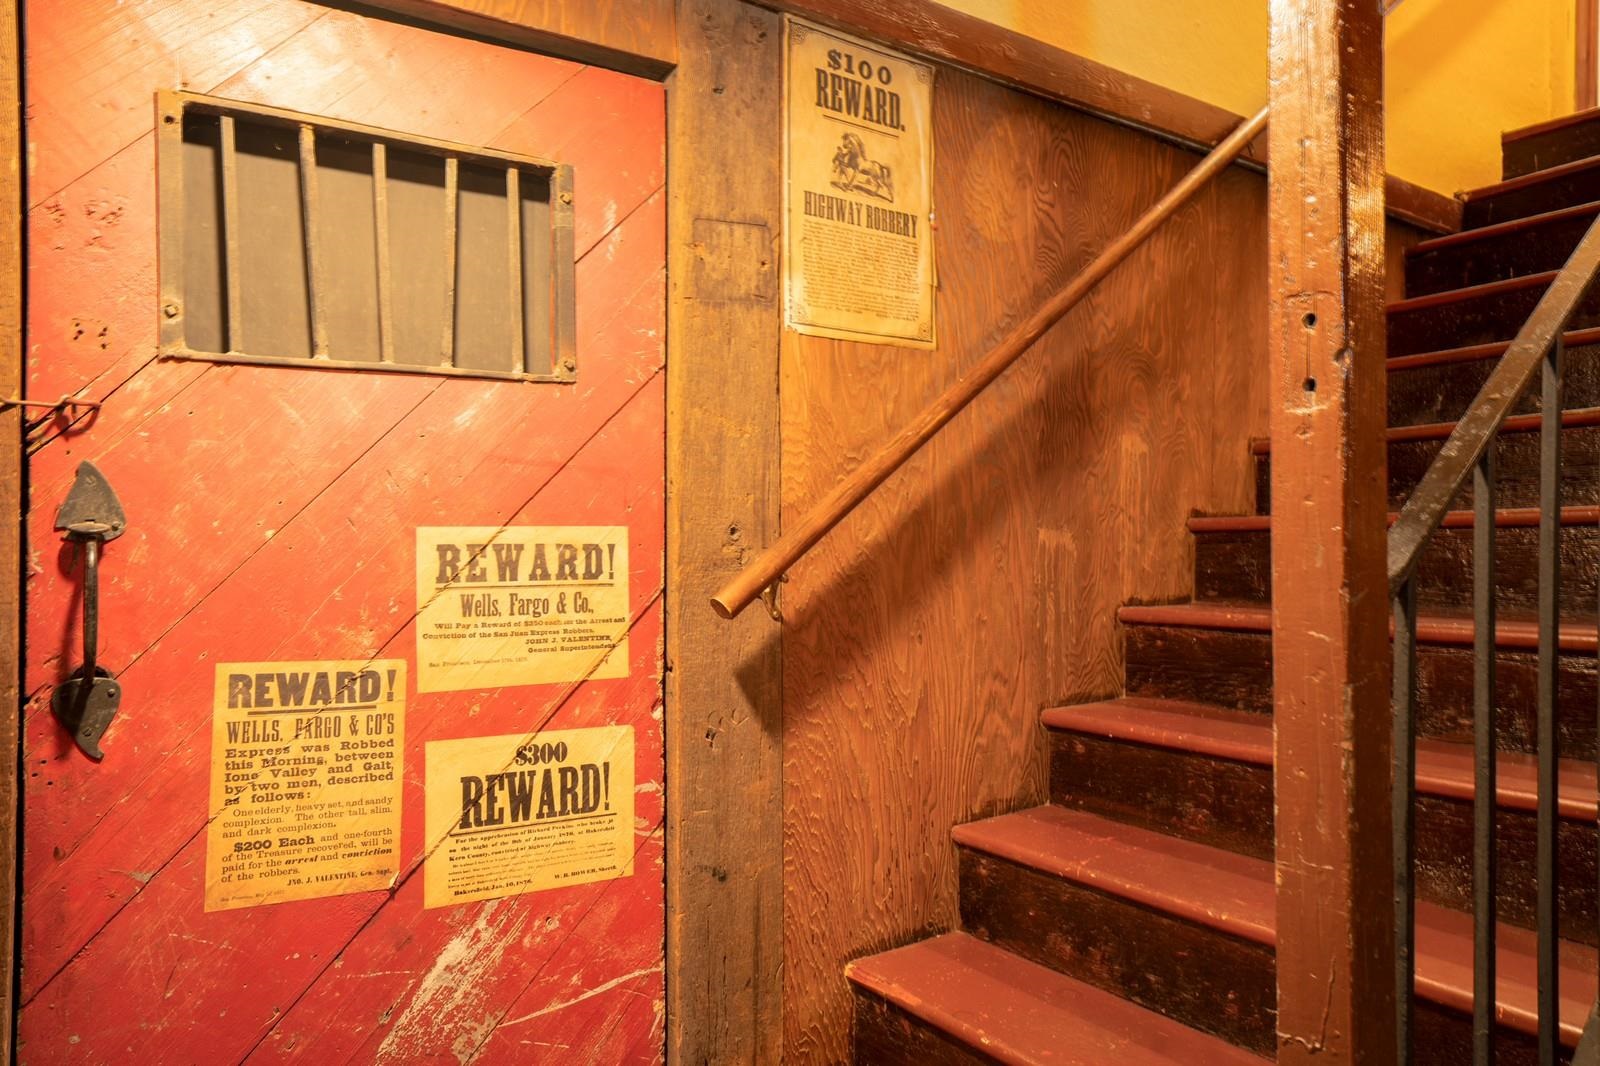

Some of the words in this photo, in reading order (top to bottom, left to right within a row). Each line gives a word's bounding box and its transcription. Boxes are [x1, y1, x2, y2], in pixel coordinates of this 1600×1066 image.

[827, 49, 892, 85] $100
[815, 67, 905, 132] REWARD.
[803, 190, 864, 227] HIGHWAY
[865, 204, 918, 239] ROBBERY
[435, 543, 616, 584] REWARD!
[460, 594, 502, 617] Wells,
[509, 592, 549, 618] Fargo
[556, 591, 567, 614] &
[227, 669, 397, 710] REWARD!
[295, 715, 341, 740] FARGO
[349, 714, 360, 737] &
[366, 713, 394, 737] CO'S
[225, 746, 290, 759] Express
[301, 744, 330, 753] was
[340, 738, 394, 751] Robbed
[225, 760, 253, 771] this
[261, 755, 327, 769] Morning,
[335, 750, 394, 763] between
[515, 741, 568, 766] $300
[224, 771, 260, 783] Ione
[270, 766, 317, 781] Valley
[327, 763, 353, 774] and
[363, 760, 394, 773] Galt,
[224, 784, 244, 796] by
[251, 782, 280, 791] two
[287, 779, 322, 790] men,
[327, 771, 394, 785] described
[233, 808, 254, 817] One
[295, 802, 326, 813] heavy
[345, 798, 363, 807] and
[365, 796, 393, 806] sandy
[251, 792, 311, 804] follows:
[458, 761, 610, 830] REWARD!
[295, 812, 314, 822] The
[318, 810, 344, 820] other
[222, 829, 242, 838] and
[247, 826, 271, 837] dark
[276, 821, 337, 834] complexion.
[233, 840, 272, 852] $200
[278, 836, 315, 848] Each
[320, 833, 338, 842] and
[344, 828, 393, 840] one-fourth
[480, 832, 519, 842] apprehension
[532, 834, 556, 842] January
[221, 863, 245, 874] paid
[248, 860, 263, 870] for
[266, 858, 282, 868] the
[284, 855, 319, 866] arrest
[320, 853, 338, 862] and
[341, 847, 393, 859] conviction
[222, 854, 232, 863] of
[236, 852, 253, 861] the
[256, 847, 303, 859] Treasure
[360, 838, 379, 847] will
[382, 837, 393, 845] be
[221, 874, 231, 883] of
[237, 872, 254, 882] the
[259, 867, 300, 879] robbers.
